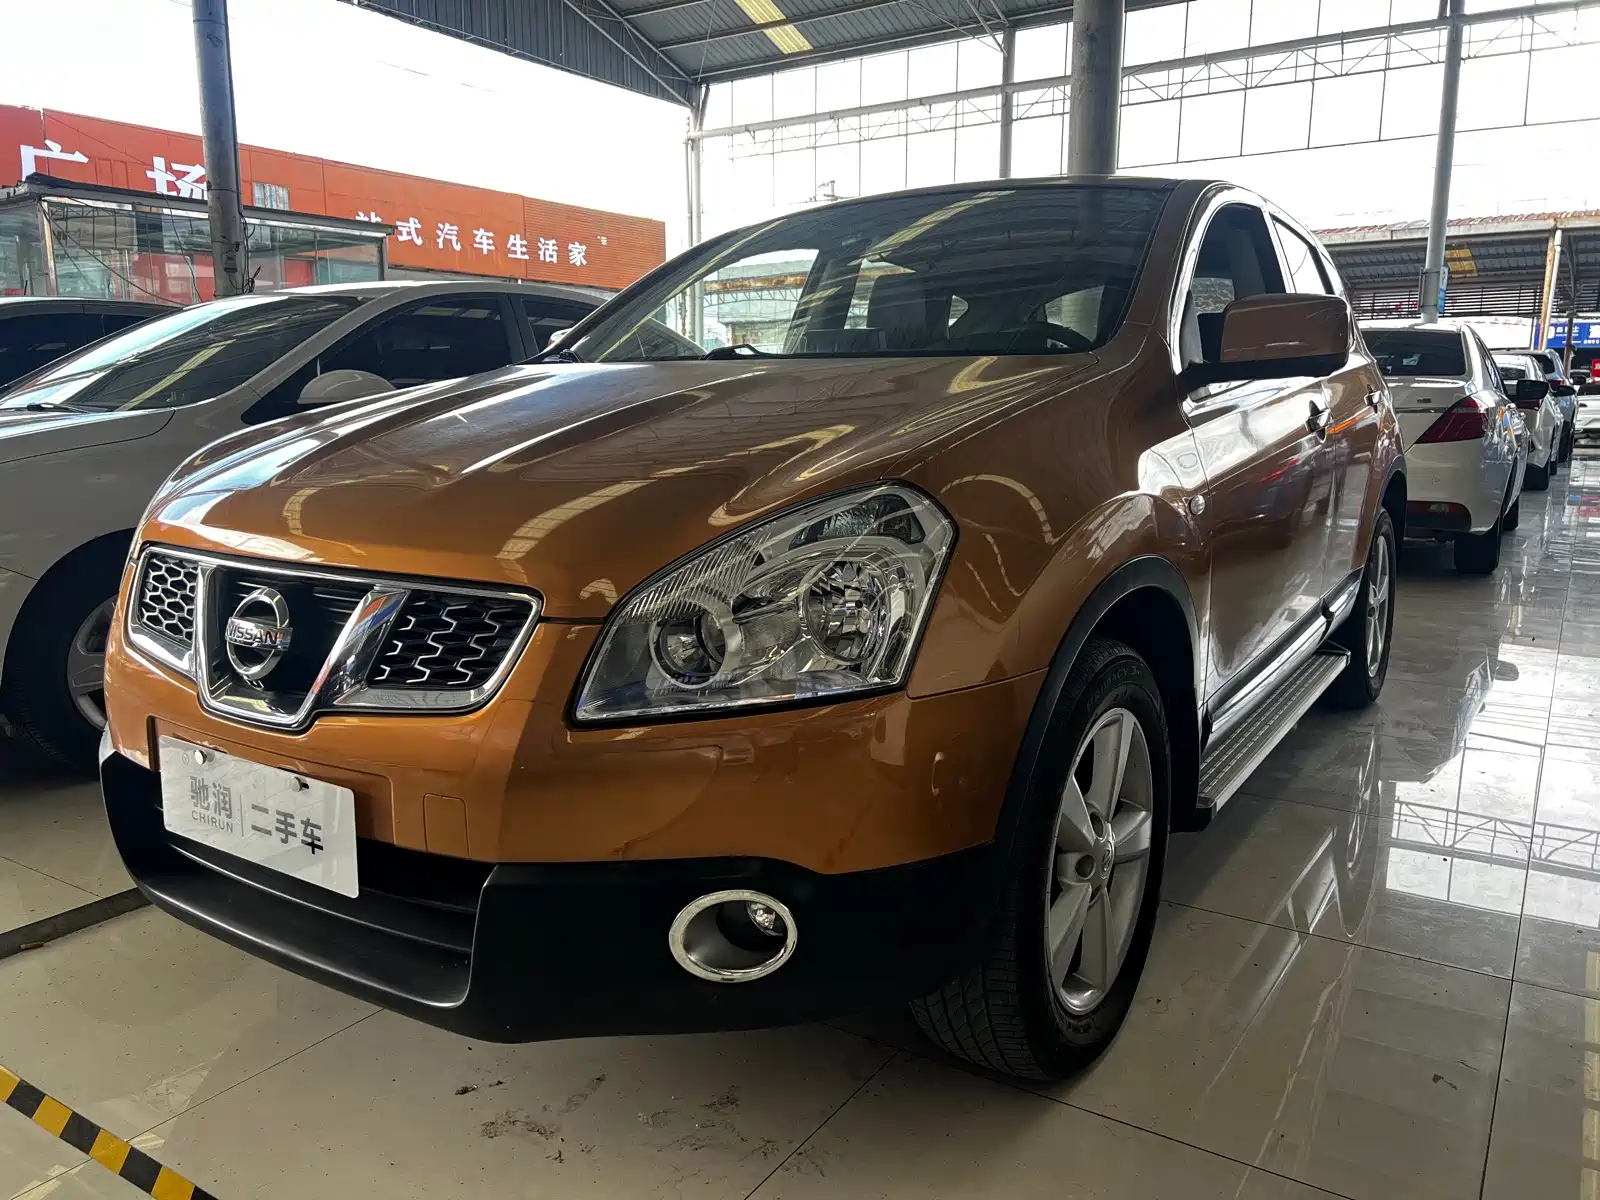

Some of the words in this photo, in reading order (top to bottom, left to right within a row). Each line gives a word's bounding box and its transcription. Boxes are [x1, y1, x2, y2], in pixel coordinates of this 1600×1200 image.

[228, 621, 279, 645] NISSAN
[190, 775, 233, 819] 驰润
[191, 810, 234, 833] CHIRUN
[251, 803, 324, 855] 二手车
